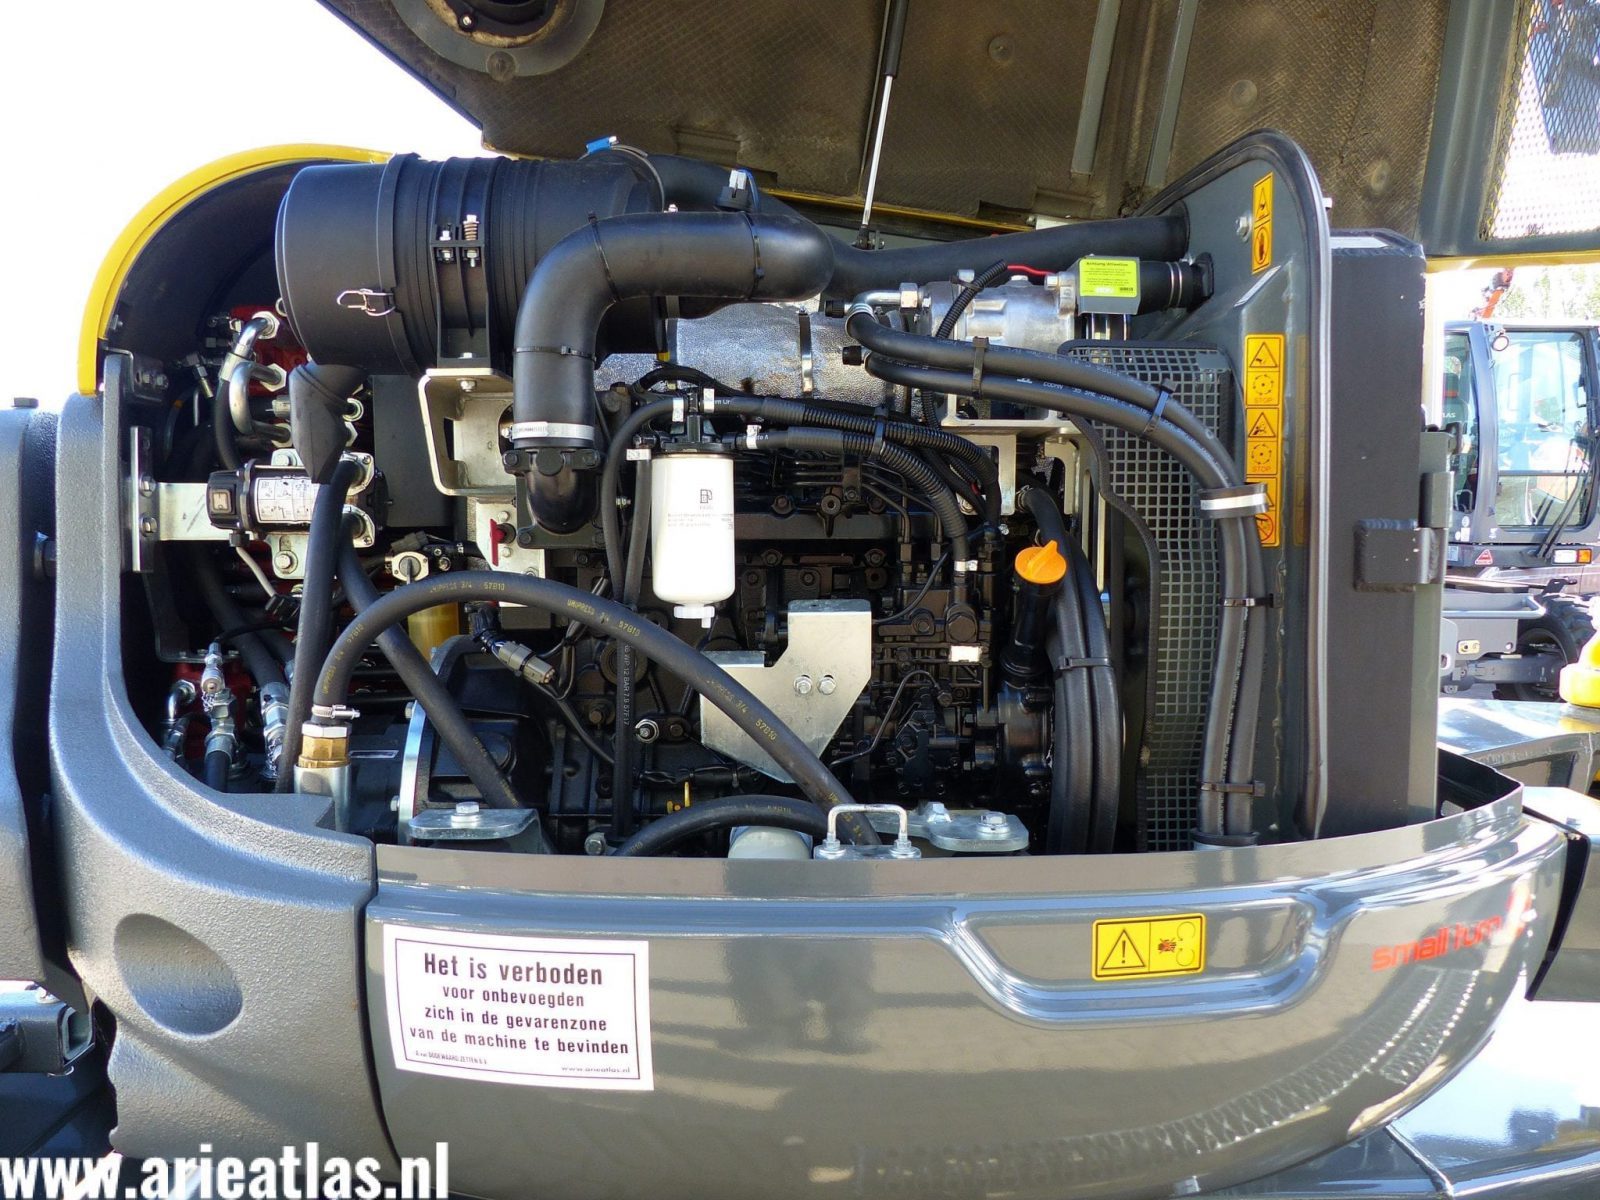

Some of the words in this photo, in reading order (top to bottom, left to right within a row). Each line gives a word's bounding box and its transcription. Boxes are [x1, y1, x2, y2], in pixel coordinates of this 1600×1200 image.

[1371, 926, 1450, 973] small
[424, 952, 459, 977] Het
[469, 957, 488, 980] is
[499, 961, 604, 986] verboden
[442, 985, 475, 1000] voor
[482, 988, 585, 1009] onbevoegden
[424, 1006, 454, 1022] zich
[461, 1008, 475, 1024] in
[482, 1010, 499, 1026] de
[506, 1014, 608, 1032] gevarenzone
[409, 1025, 434, 1041] van
[441, 1028, 458, 1043] de
[464, 1031, 527, 1051] machine
[534, 1036, 550, 1052] te
[557, 1038, 629, 1055] bevinden
